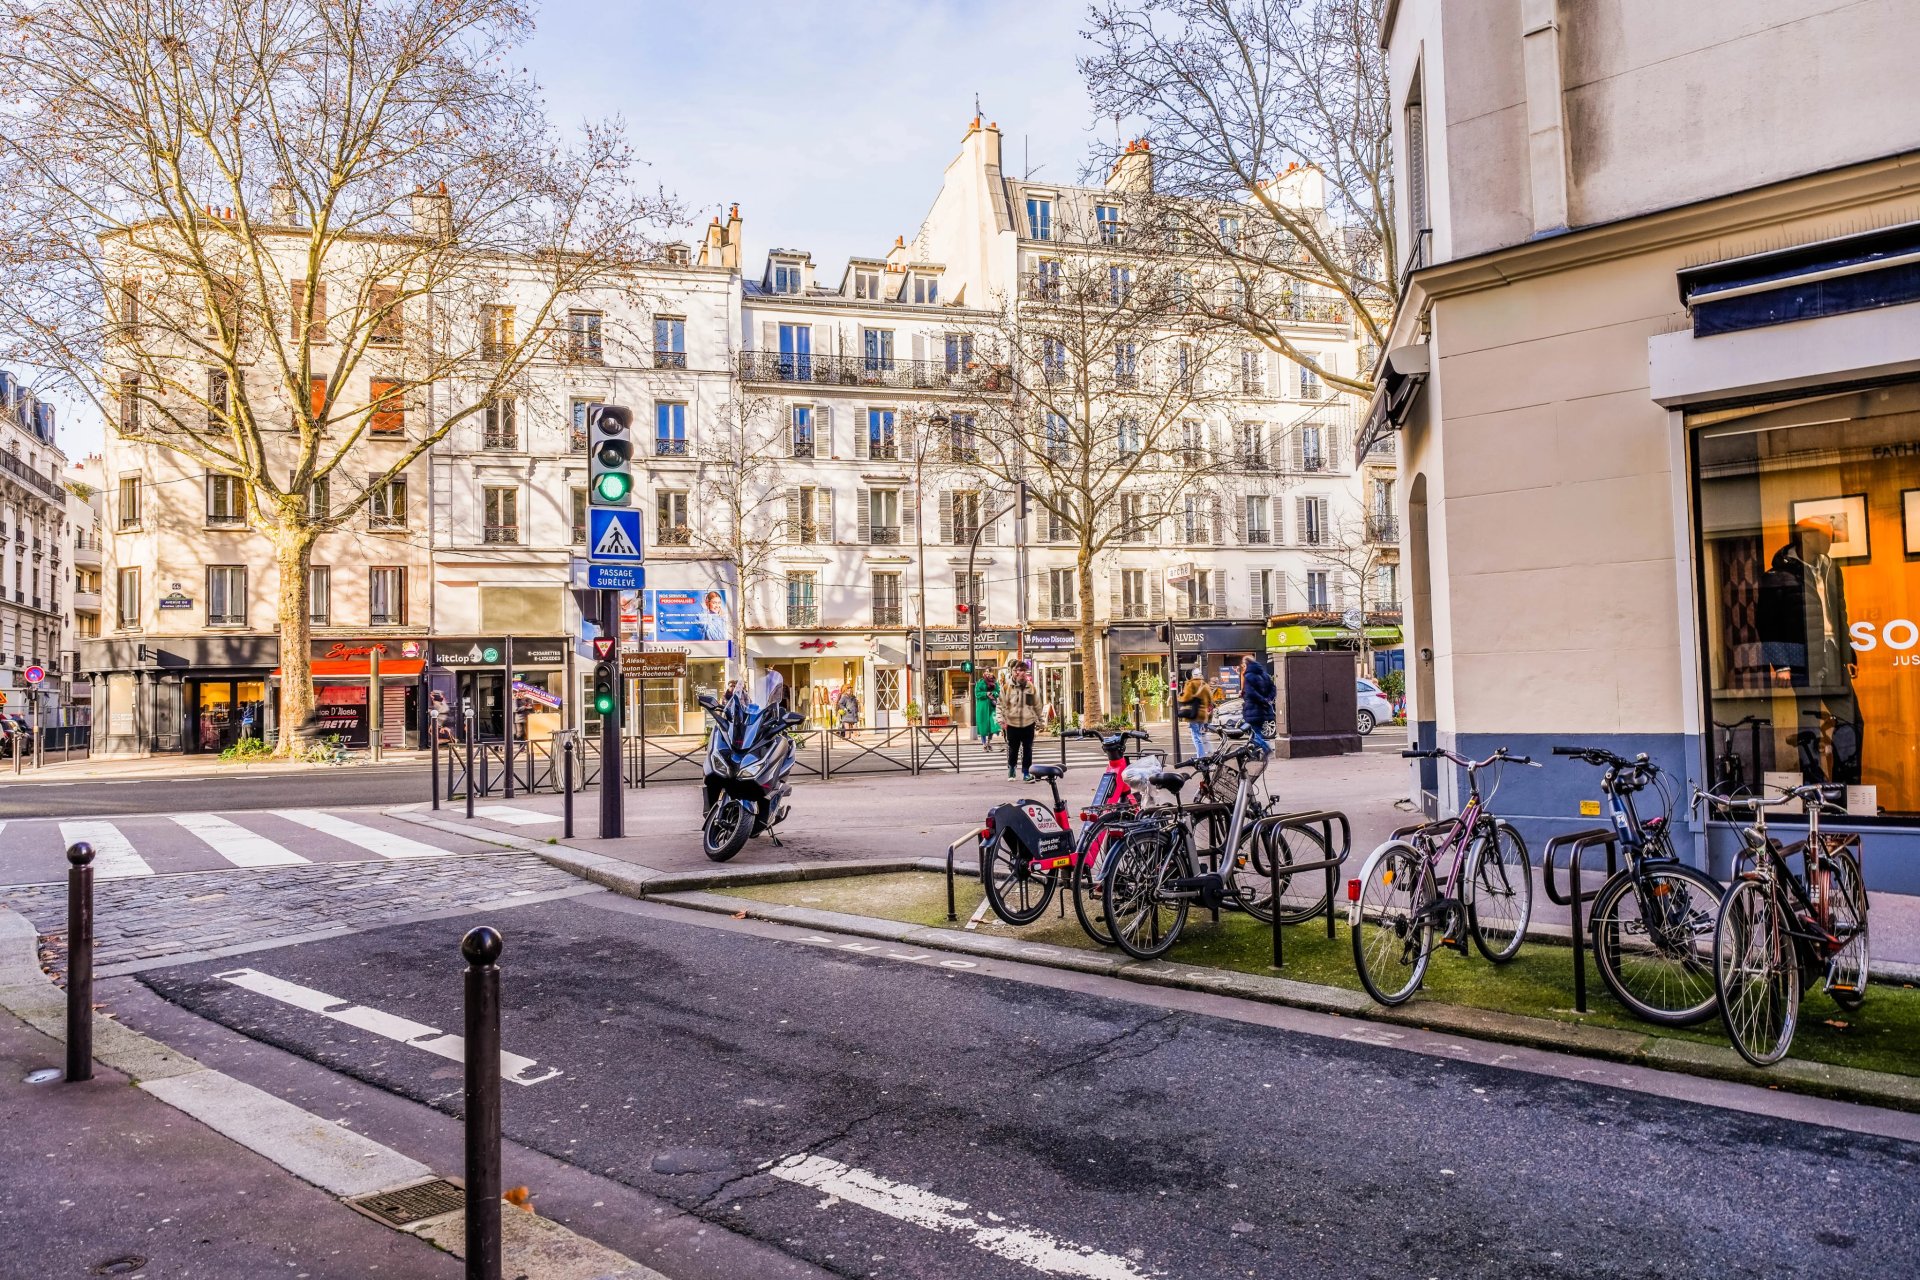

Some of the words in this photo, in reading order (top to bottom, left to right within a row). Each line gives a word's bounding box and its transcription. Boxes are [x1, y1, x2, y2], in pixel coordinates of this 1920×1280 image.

[600, 569, 632, 577] PASSAGE
[597, 577, 636, 586] SURÉLEVÉ
[933, 634, 958, 642] JEAN
[962, 634, 1000, 642] SRVET
[1174, 633, 1204, 642] ALVEUS
[436, 654, 470, 664] kitclop
[1036, 807, 1043, 822] 3
[797, 935, 976, 968] VELO
